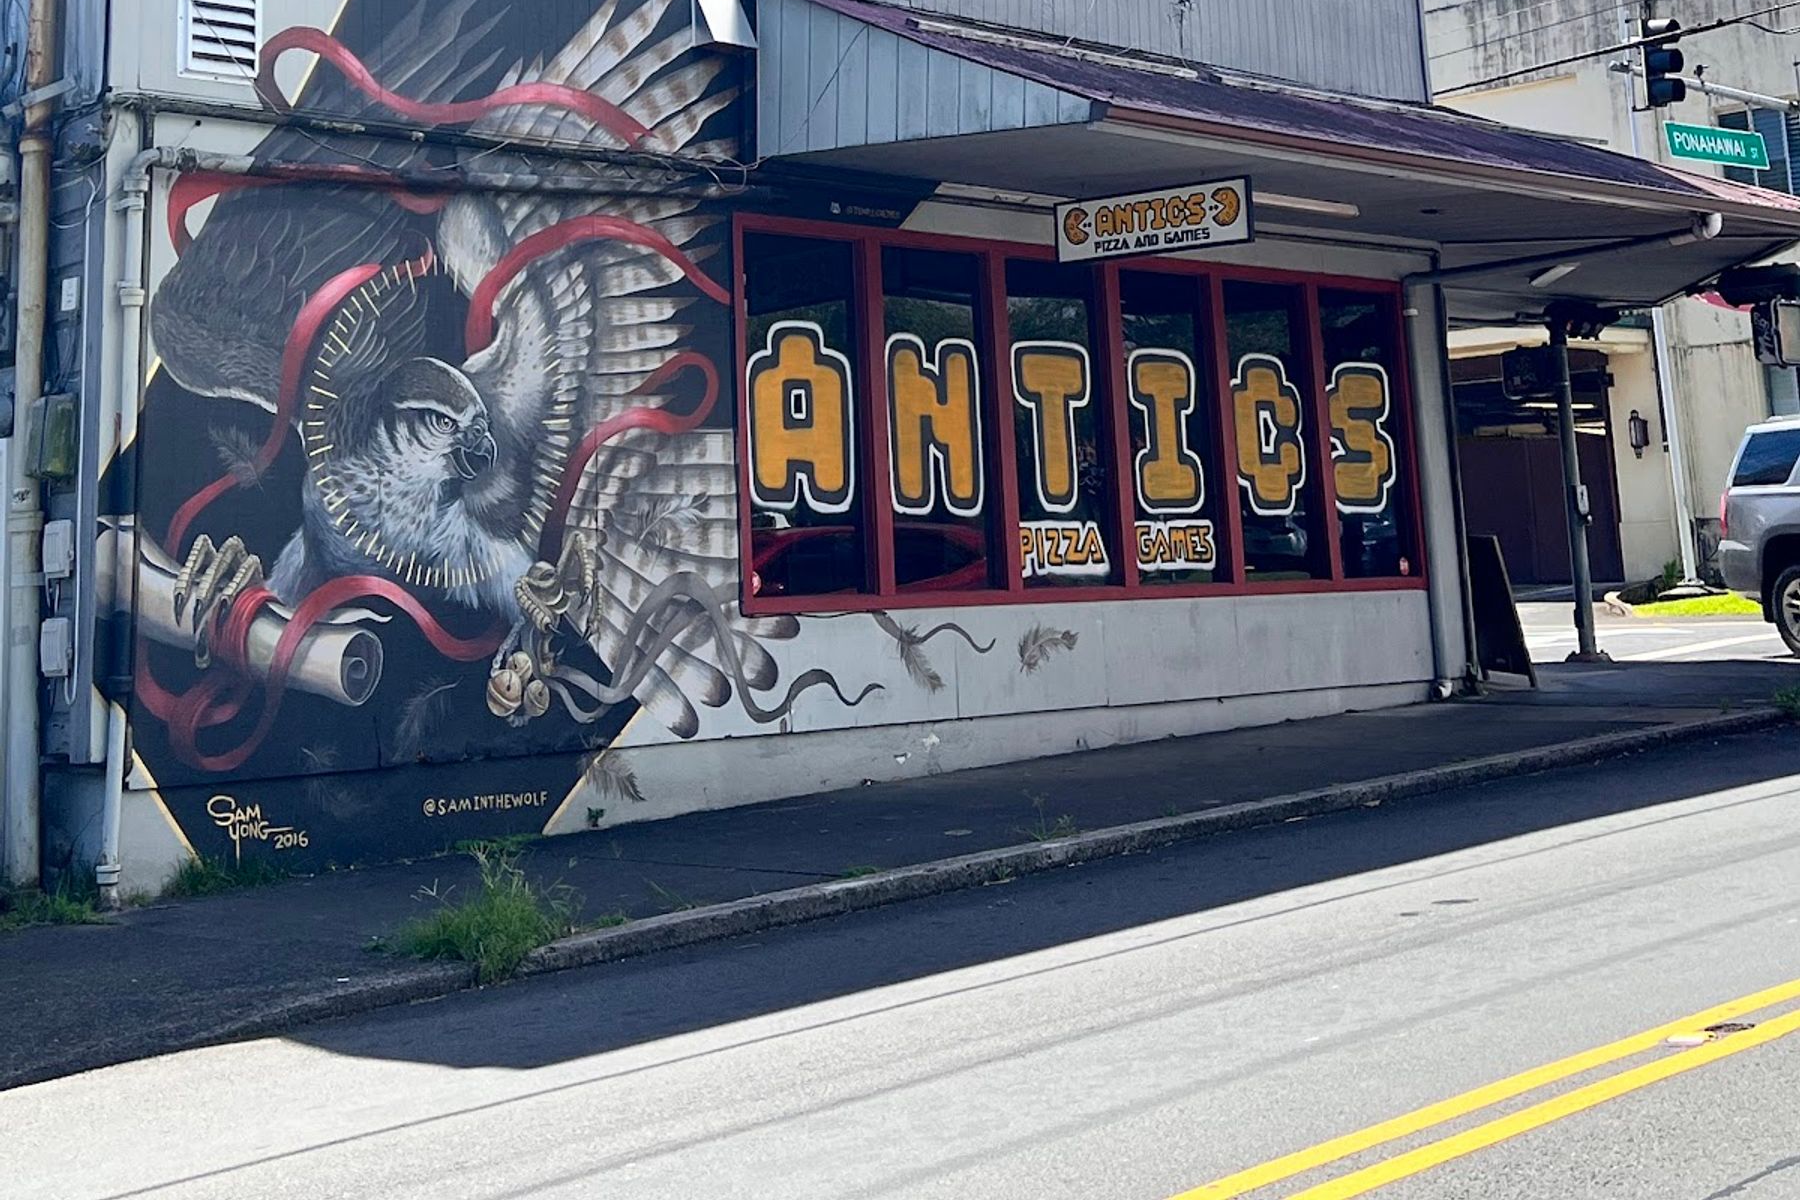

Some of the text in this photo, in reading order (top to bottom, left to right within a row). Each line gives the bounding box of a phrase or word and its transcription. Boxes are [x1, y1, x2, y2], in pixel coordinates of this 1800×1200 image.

[1672, 131, 1746, 158] PONAHAWAI
[1094, 192, 1206, 238] ANTICS
[1094, 226, 1210, 254] PIZZA AND GAMES
[746, 320, 1396, 517] ANTICS
[1019, 522, 1215, 575] PIZZA GAMES
[206, 795, 262, 827] SAM
[423, 791, 548, 817] @SAMINTHEWOLF
[228, 821, 309, 864] YONG 2016
